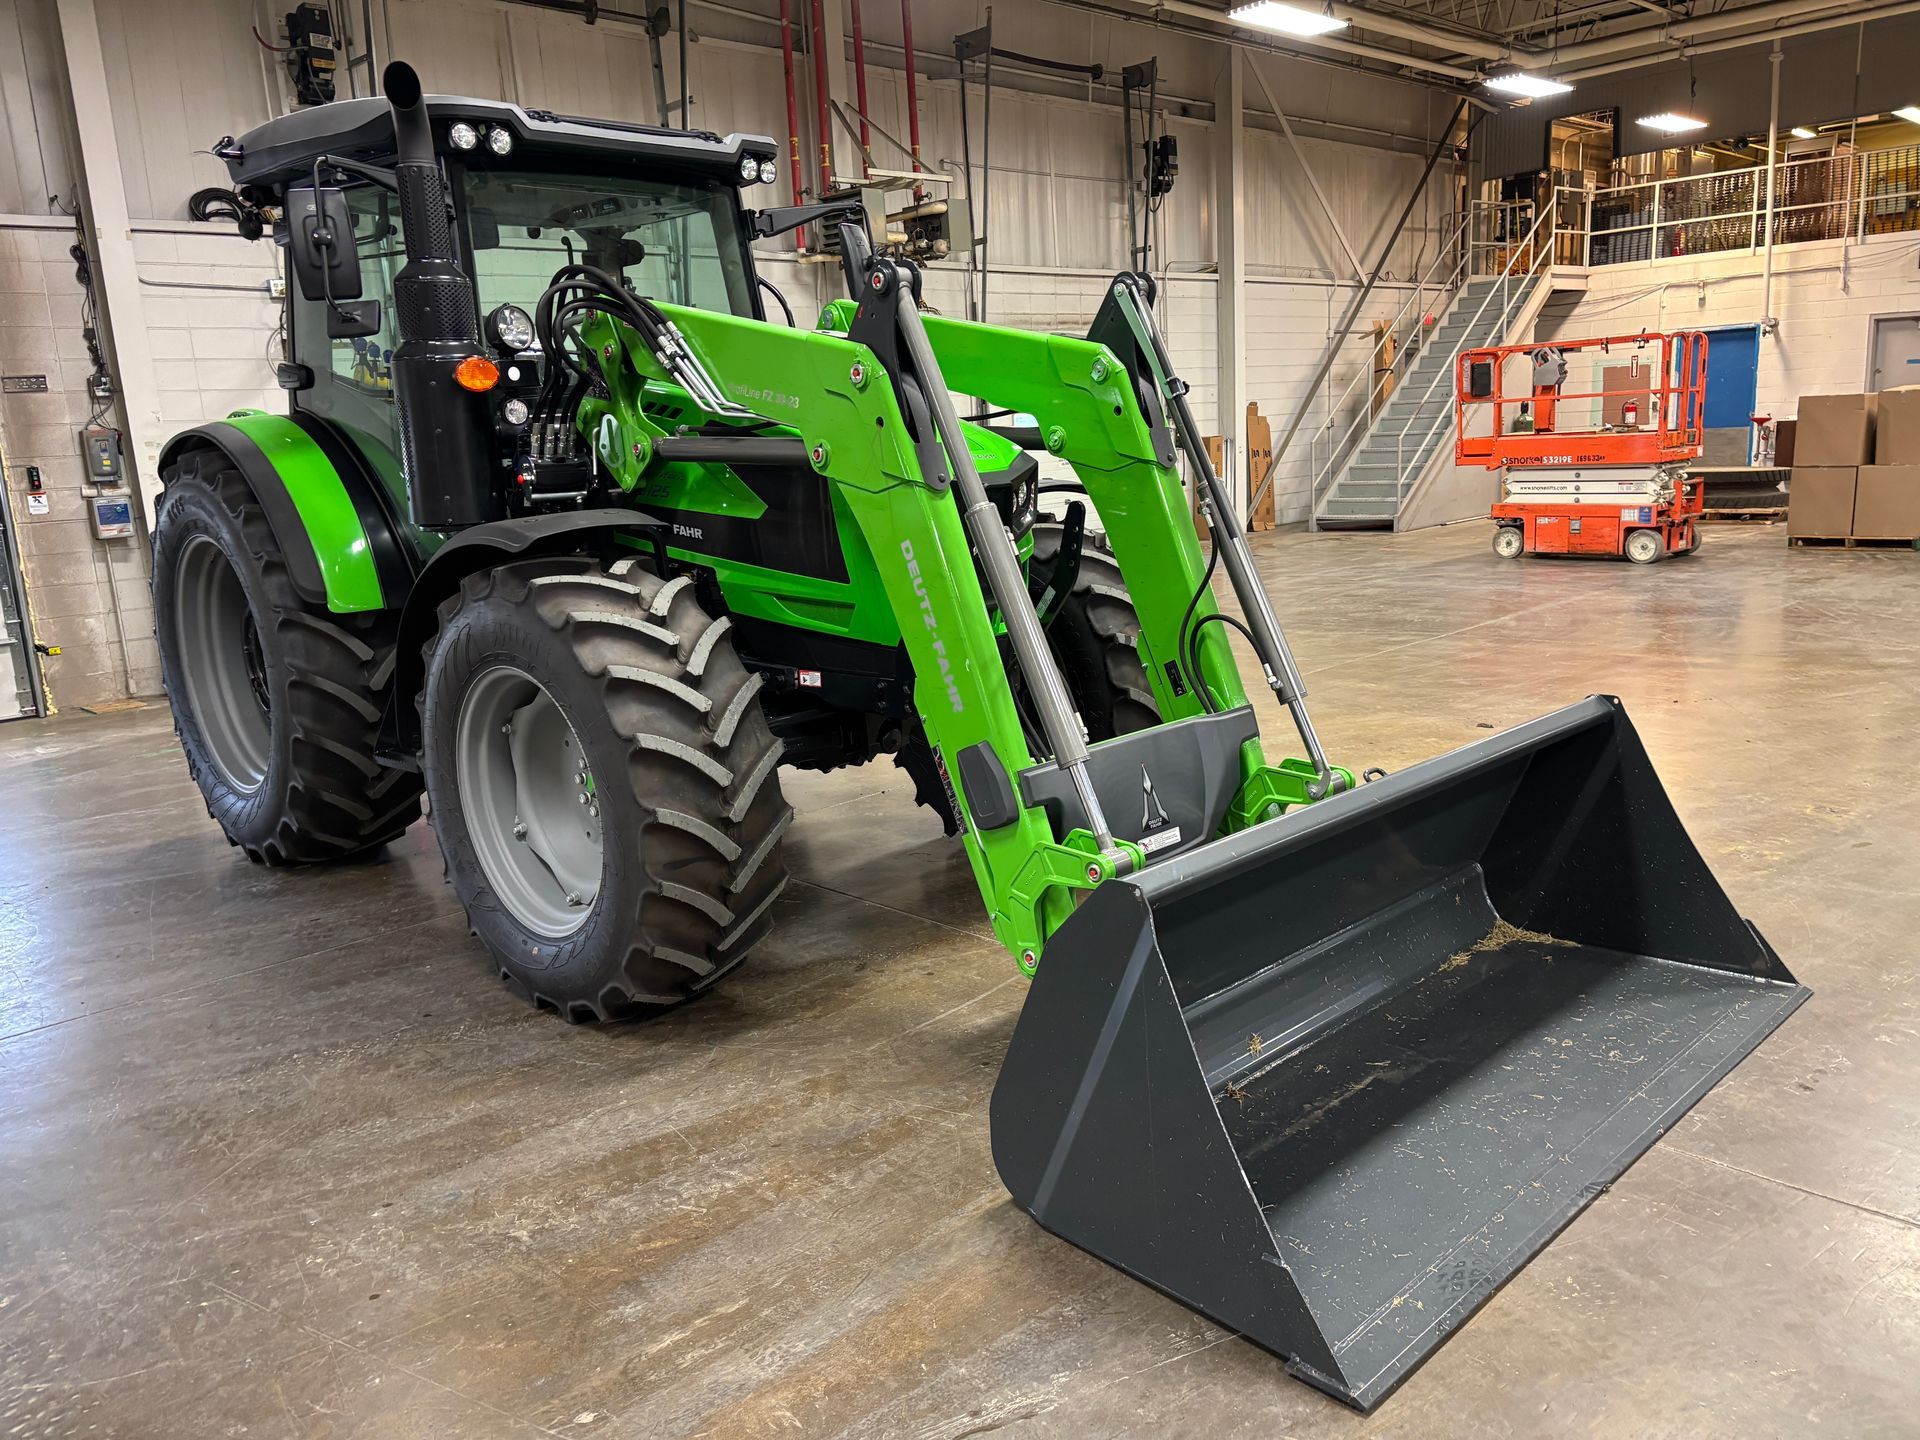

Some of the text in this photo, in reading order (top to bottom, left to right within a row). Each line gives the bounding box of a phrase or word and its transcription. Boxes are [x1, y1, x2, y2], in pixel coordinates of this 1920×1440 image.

[1543, 455, 1573, 464] S3219E
[673, 524, 703, 539] FAHR
[901, 539, 963, 713] DEUTZ-FAHR
[1148, 817, 1163, 826] DEUTZ
